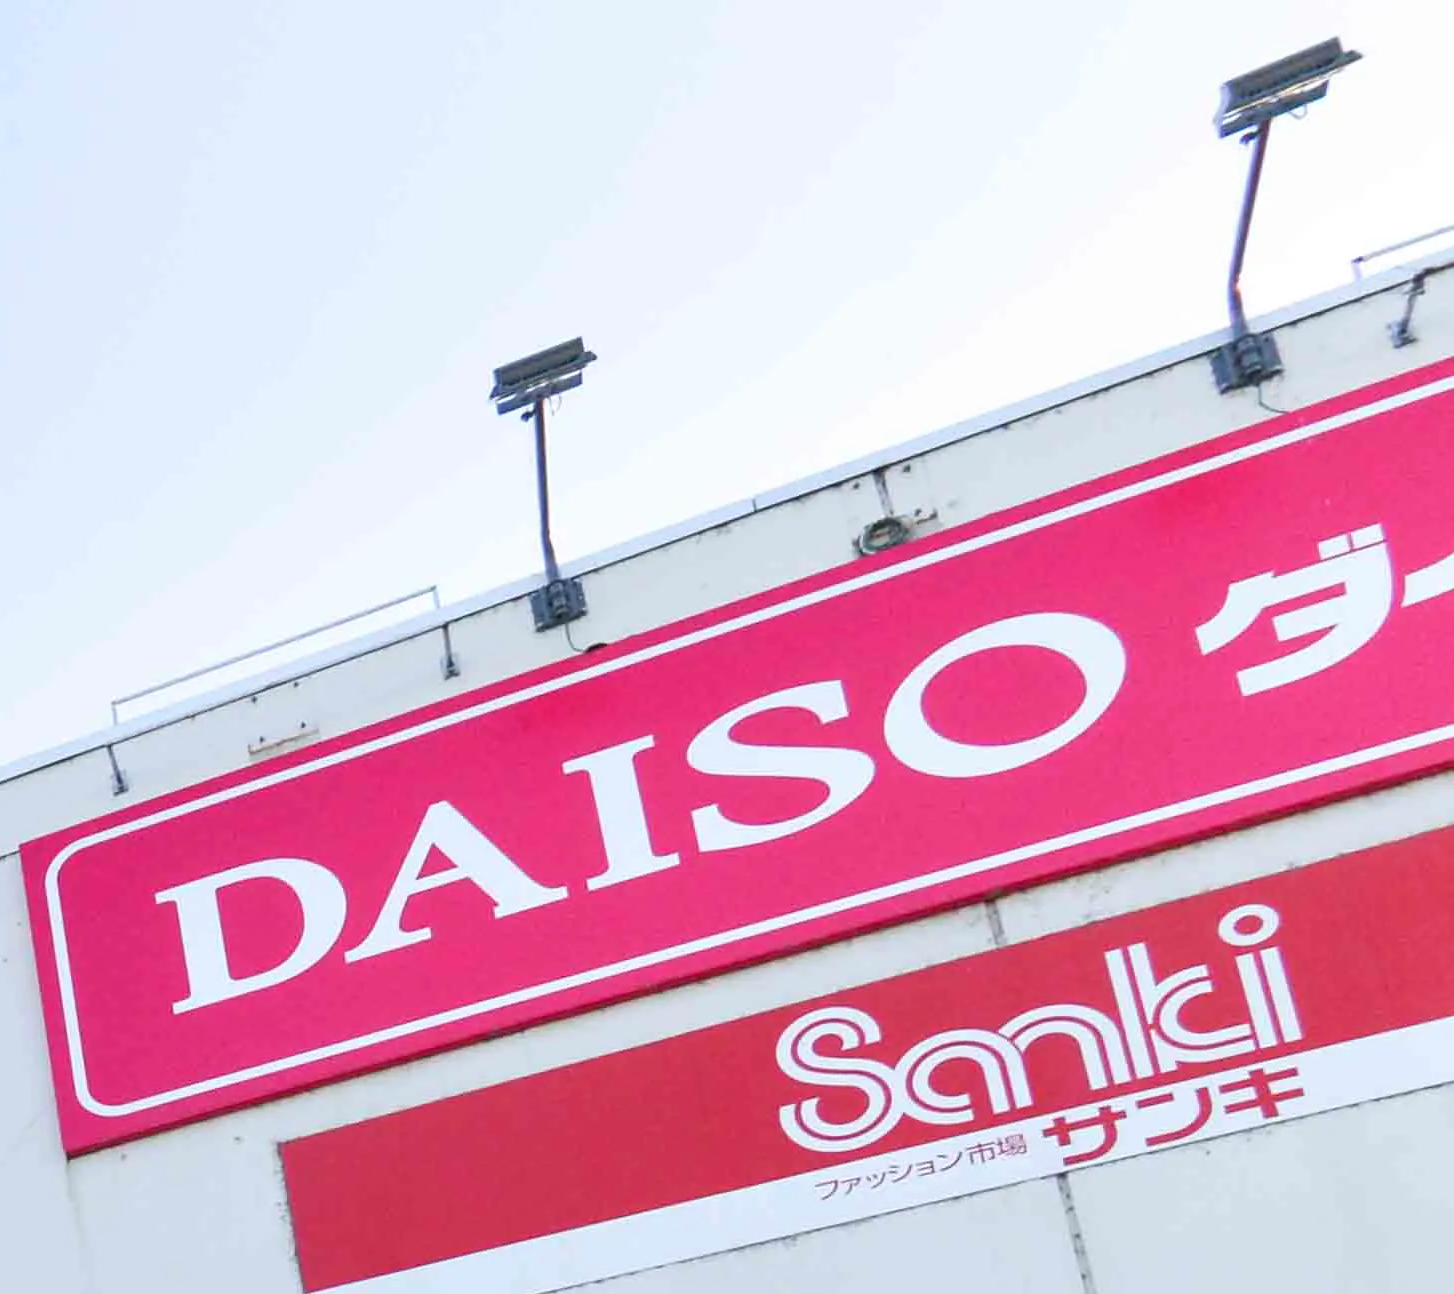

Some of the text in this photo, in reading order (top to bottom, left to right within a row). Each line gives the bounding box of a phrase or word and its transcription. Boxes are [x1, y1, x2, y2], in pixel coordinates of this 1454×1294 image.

[156, 611, 1127, 1014] DAISO
[775, 903, 1303, 1153] Sanki
[814, 1065, 1306, 1201] ファッション市場 サンキ
